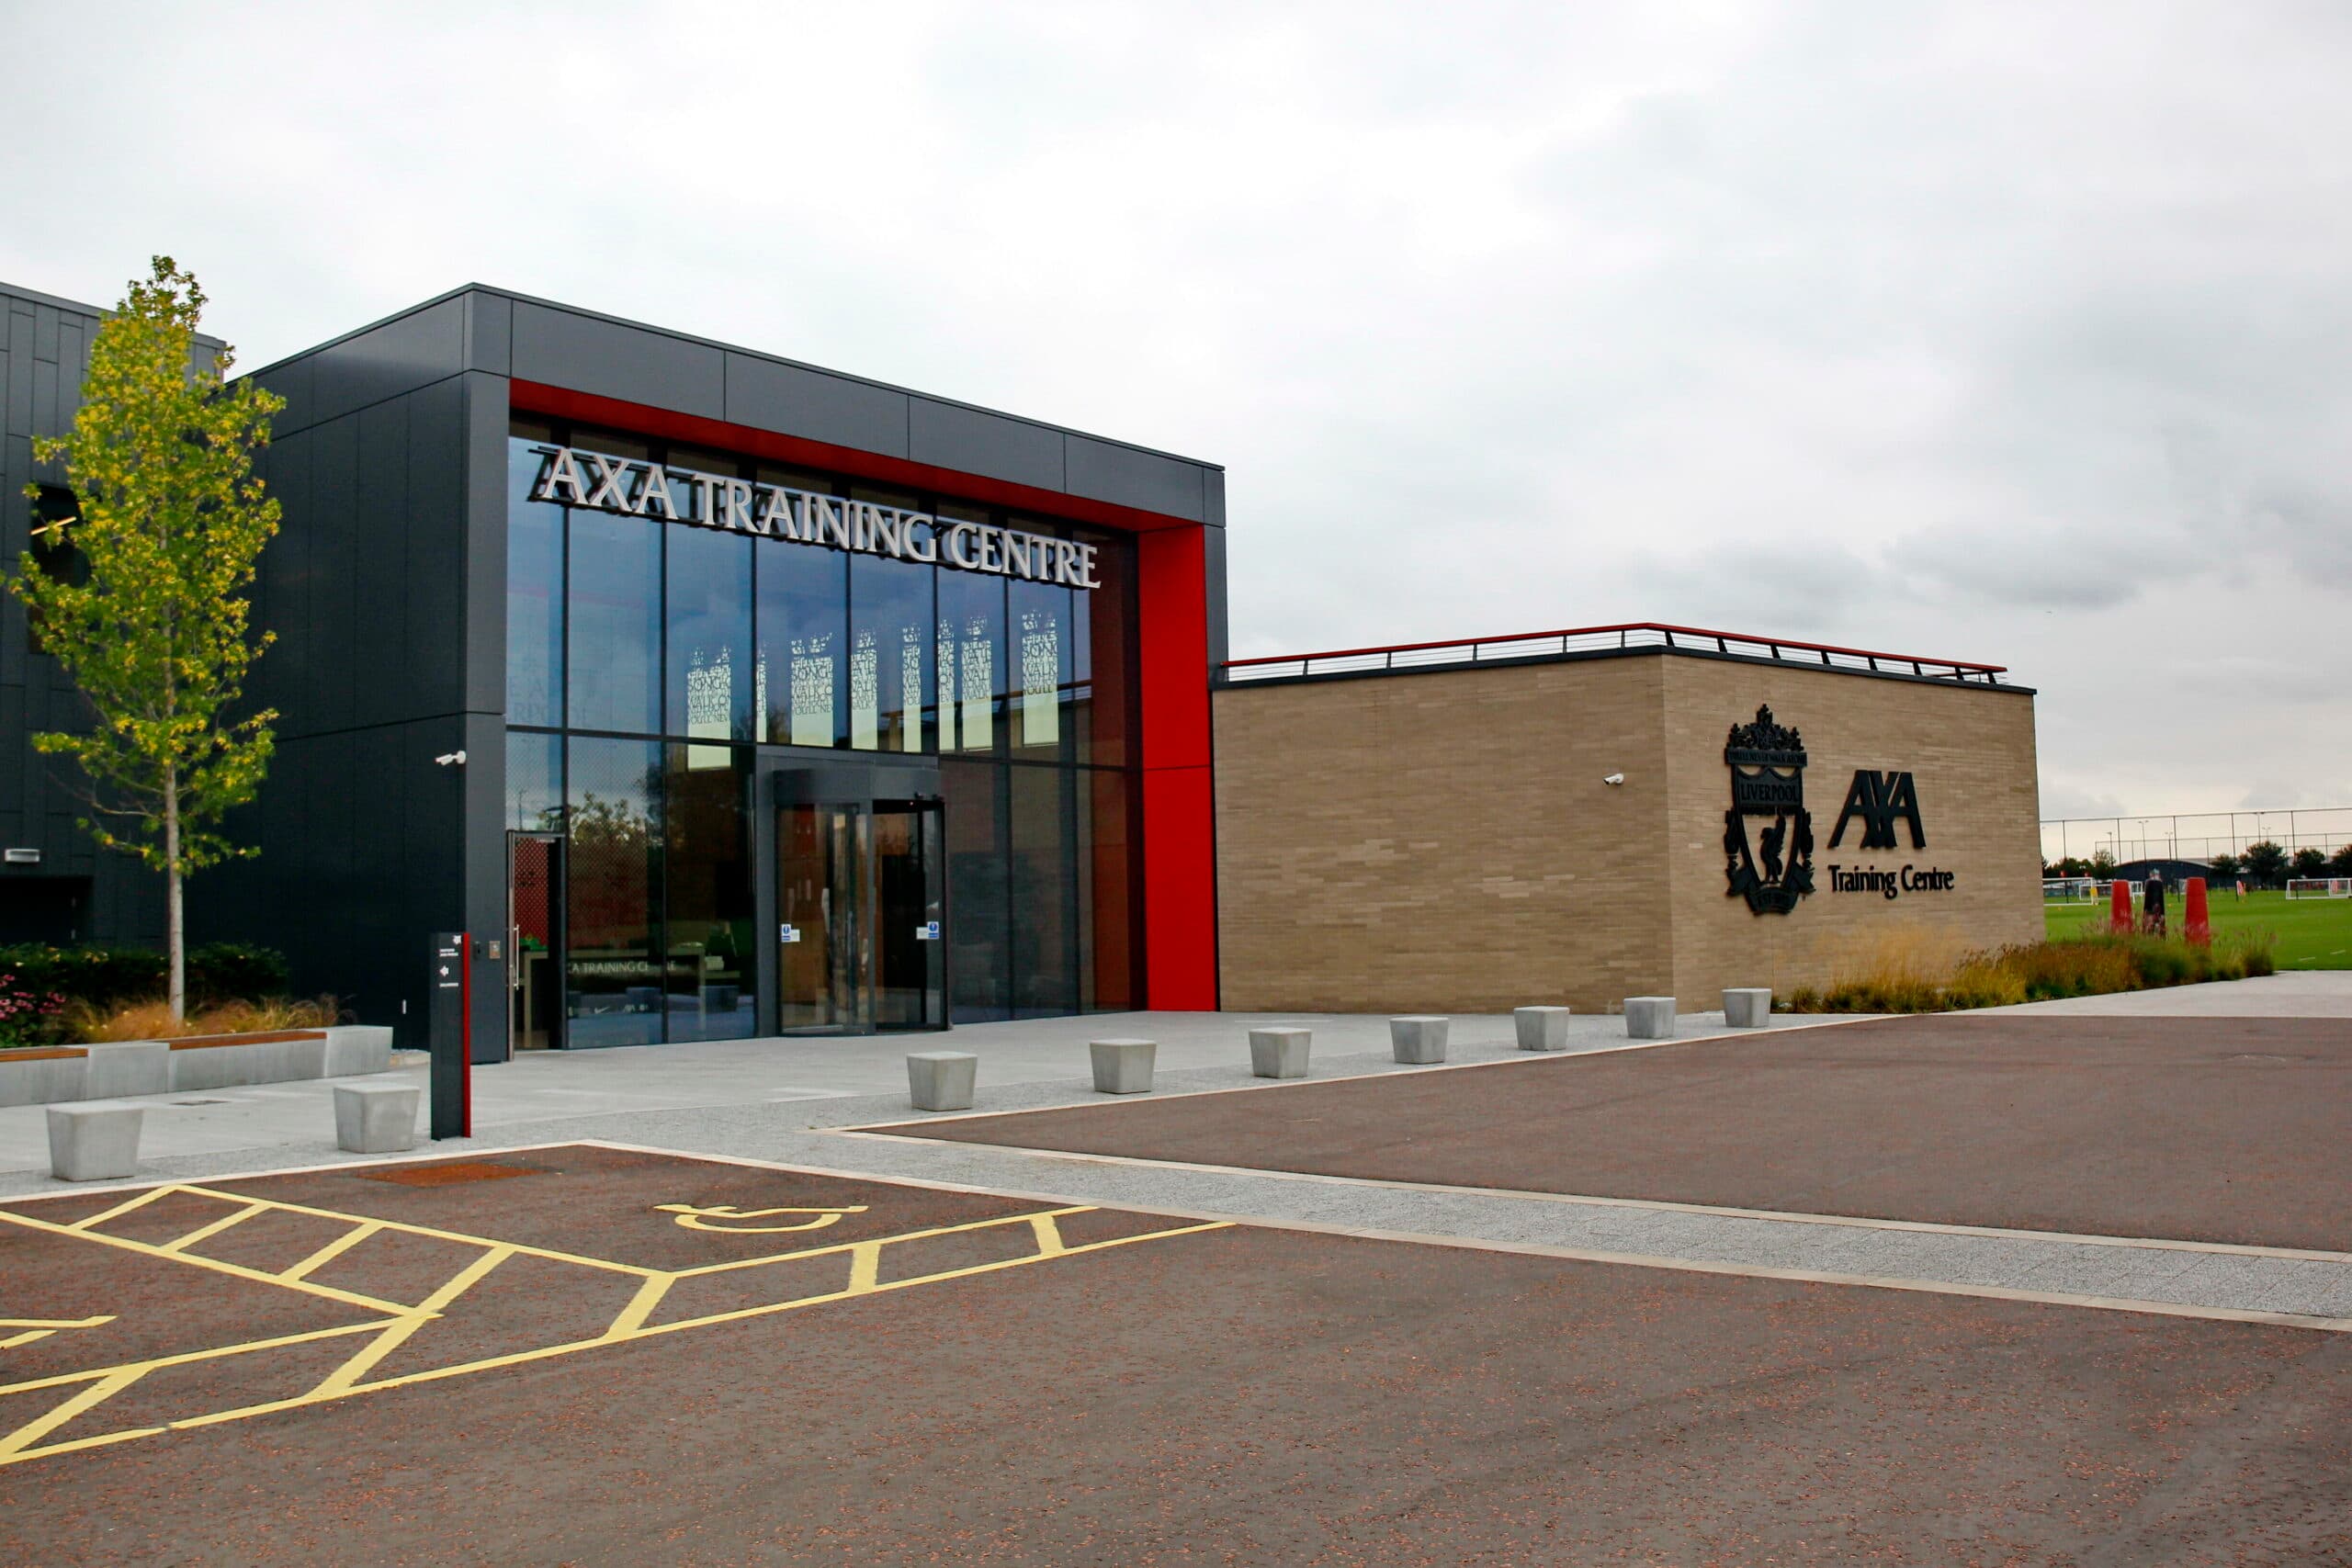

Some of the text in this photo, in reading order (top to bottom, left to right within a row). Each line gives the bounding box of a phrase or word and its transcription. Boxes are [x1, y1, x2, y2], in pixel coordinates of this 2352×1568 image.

[541, 446, 1102, 589] AXA TRAINING CENTRE
[1740, 784, 1799, 802] LIVERPOOL
[1827, 769, 1927, 850] AXA
[1827, 864, 1954, 899] Training Centre
